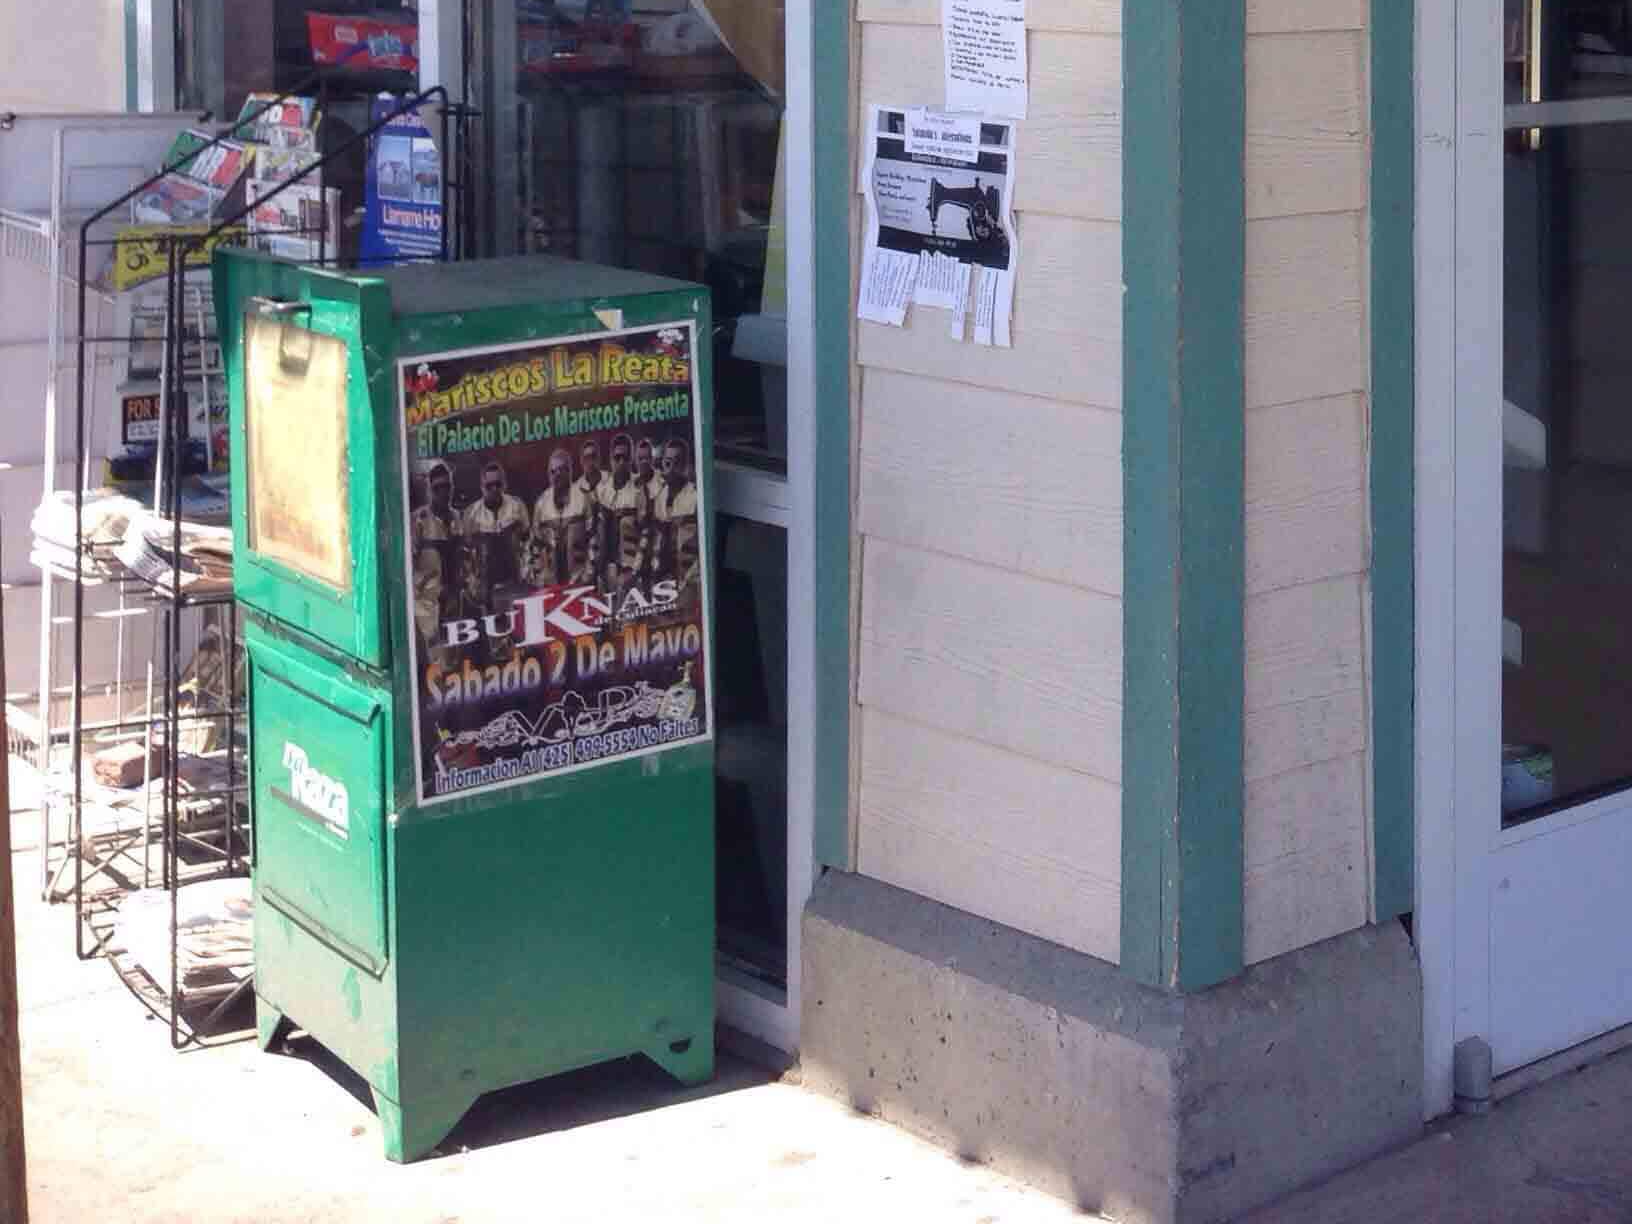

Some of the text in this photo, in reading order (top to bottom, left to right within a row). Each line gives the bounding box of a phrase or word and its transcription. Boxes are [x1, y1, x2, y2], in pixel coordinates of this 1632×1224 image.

[404, 345, 690, 424] Mariscos La Reata
[416, 392, 689, 456] El Palacio De Los Mariscos Presenta
[426, 649, 541, 705] Sabado
[575, 635, 616, 677] De
[623, 623, 700, 666] Mayo
